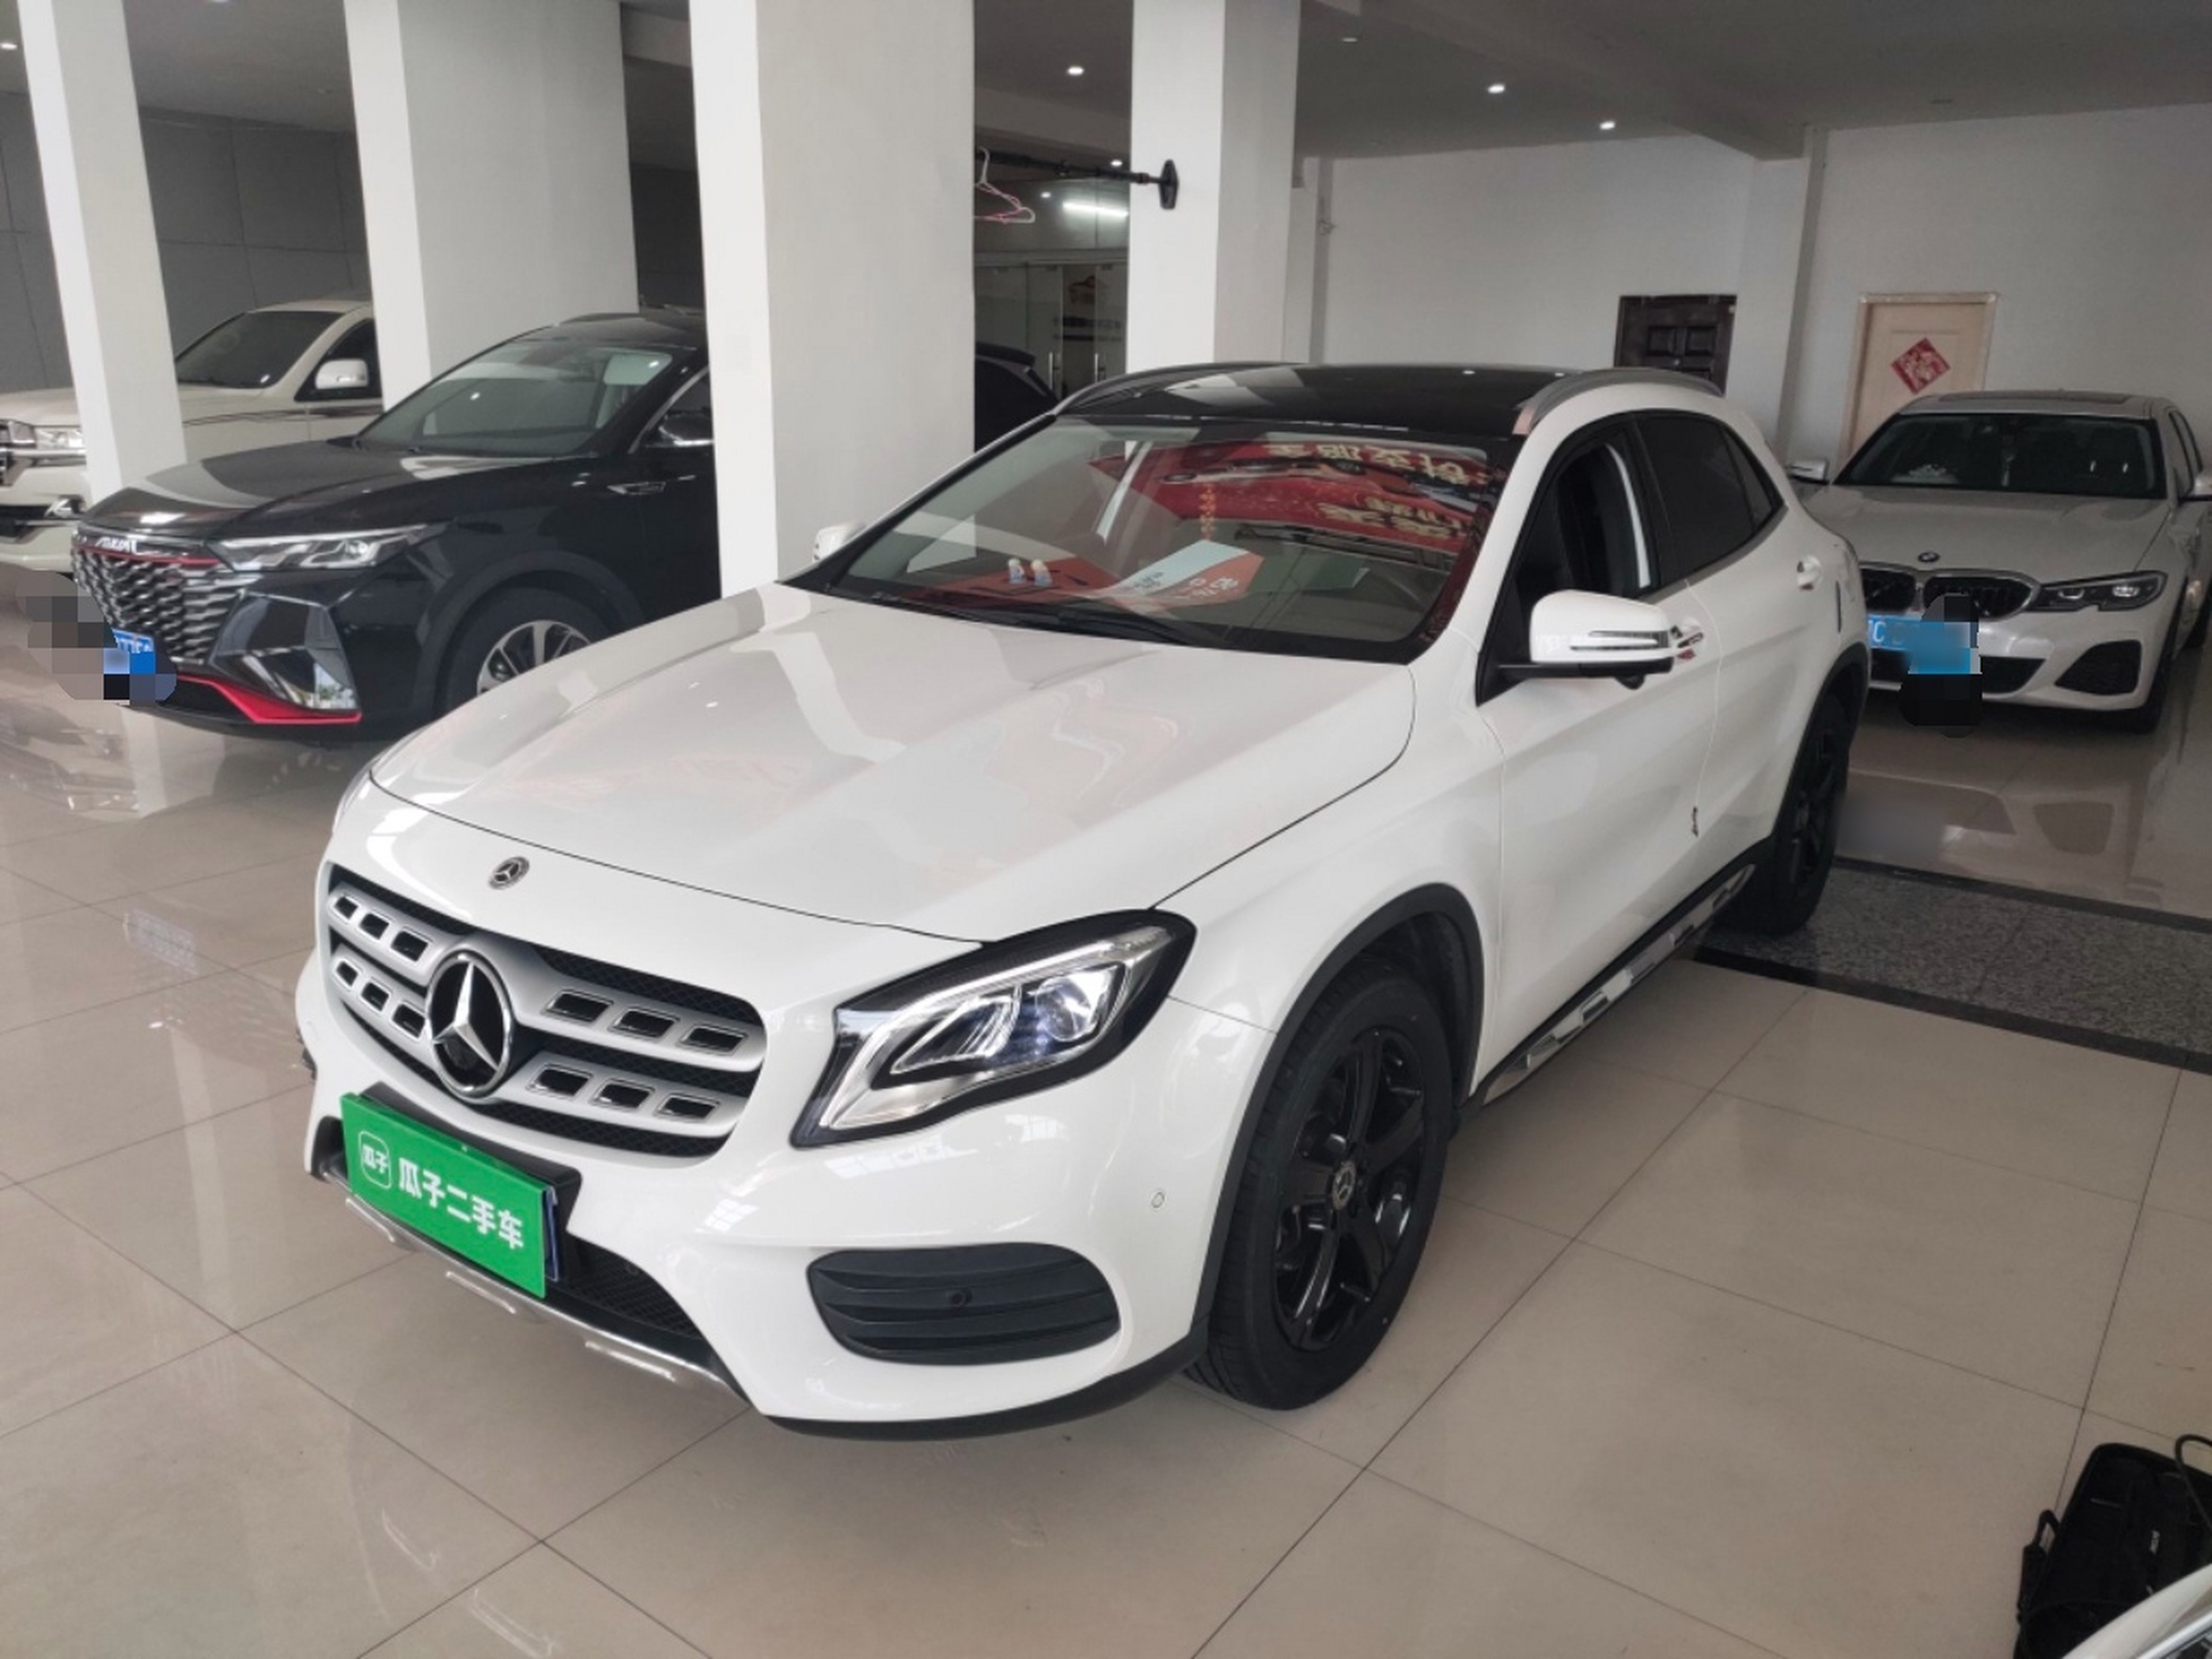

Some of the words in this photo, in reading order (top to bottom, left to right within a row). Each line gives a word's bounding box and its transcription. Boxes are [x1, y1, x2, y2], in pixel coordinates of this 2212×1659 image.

[362, 1143, 388, 1174] 瓜子
[399, 1157, 524, 1249] 瓜子二手车
